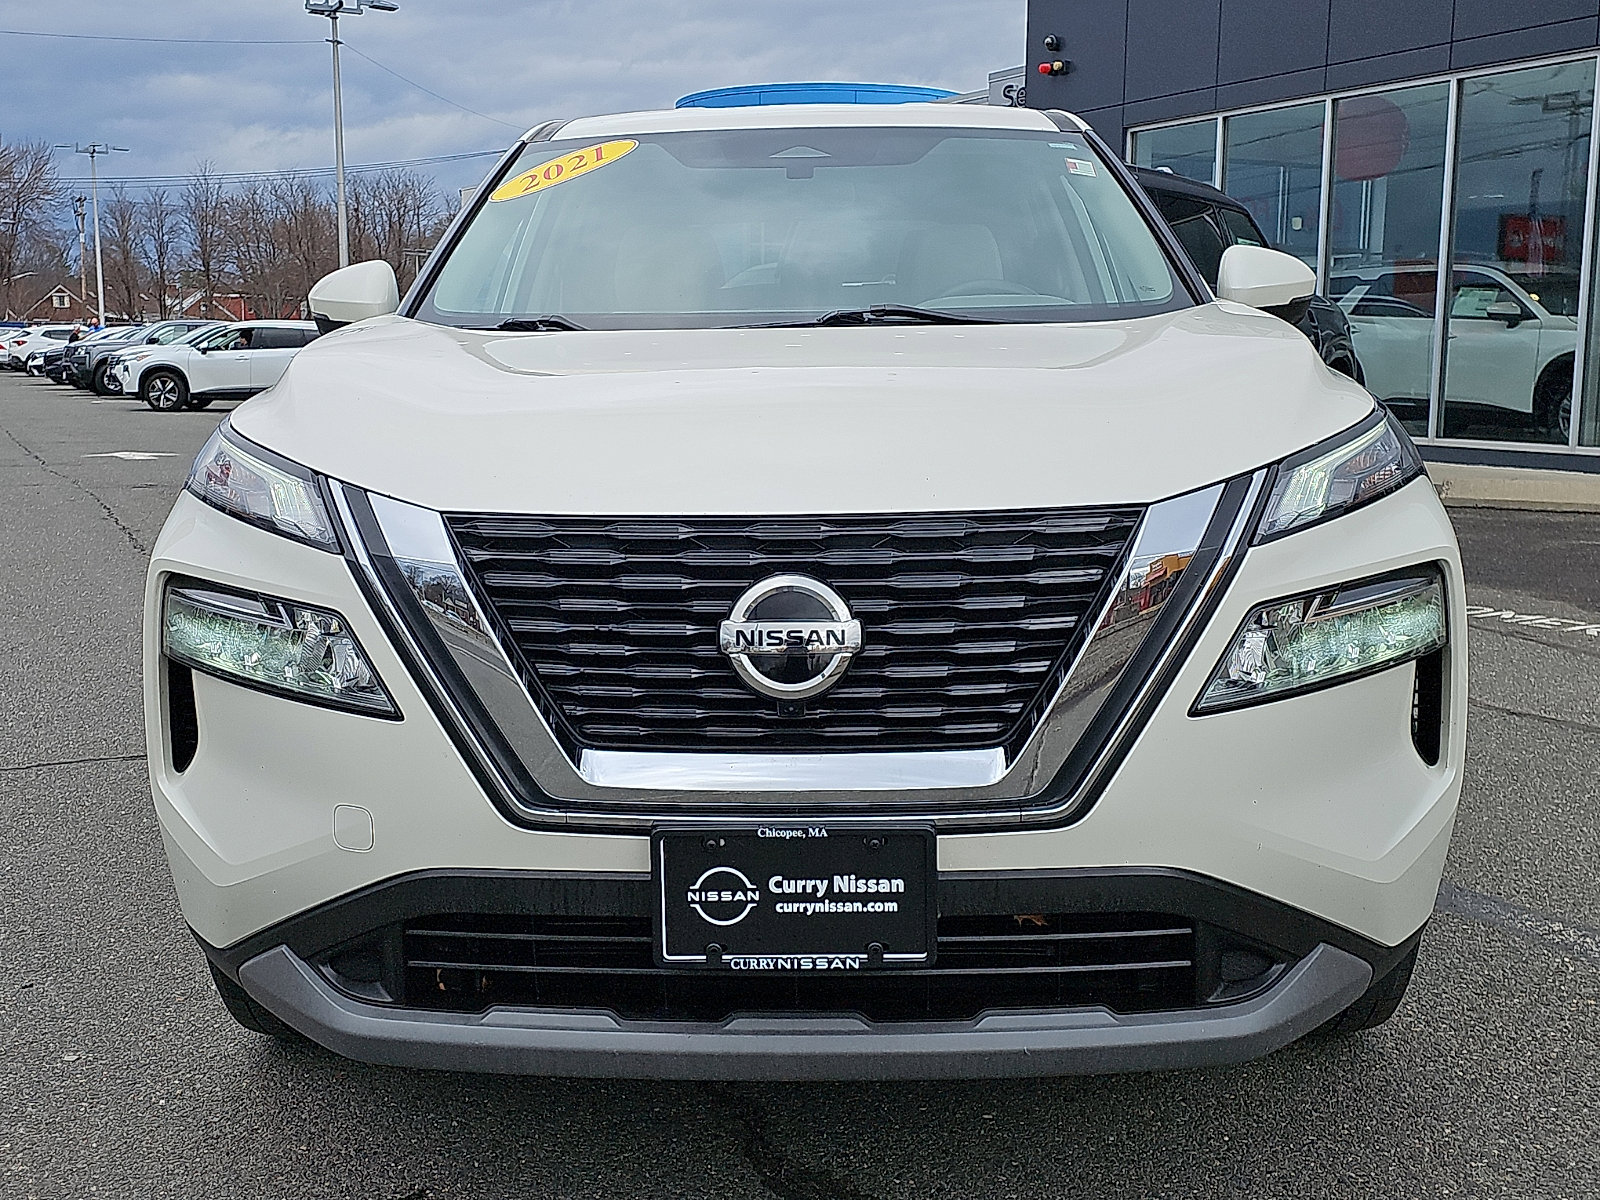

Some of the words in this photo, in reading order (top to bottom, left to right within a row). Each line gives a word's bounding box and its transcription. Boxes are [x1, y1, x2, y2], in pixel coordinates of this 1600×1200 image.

[519, 146, 609, 193] 2021
[735, 629, 846, 647] NISSAN
[757, 827, 806, 839] Chicopee,
[807, 827, 828, 838] MA
[768, 875, 829, 898] Curry
[833, 874, 905, 894] Nissan
[687, 890, 760, 902] NISSAN
[775, 899, 898, 915] currynissan.com
